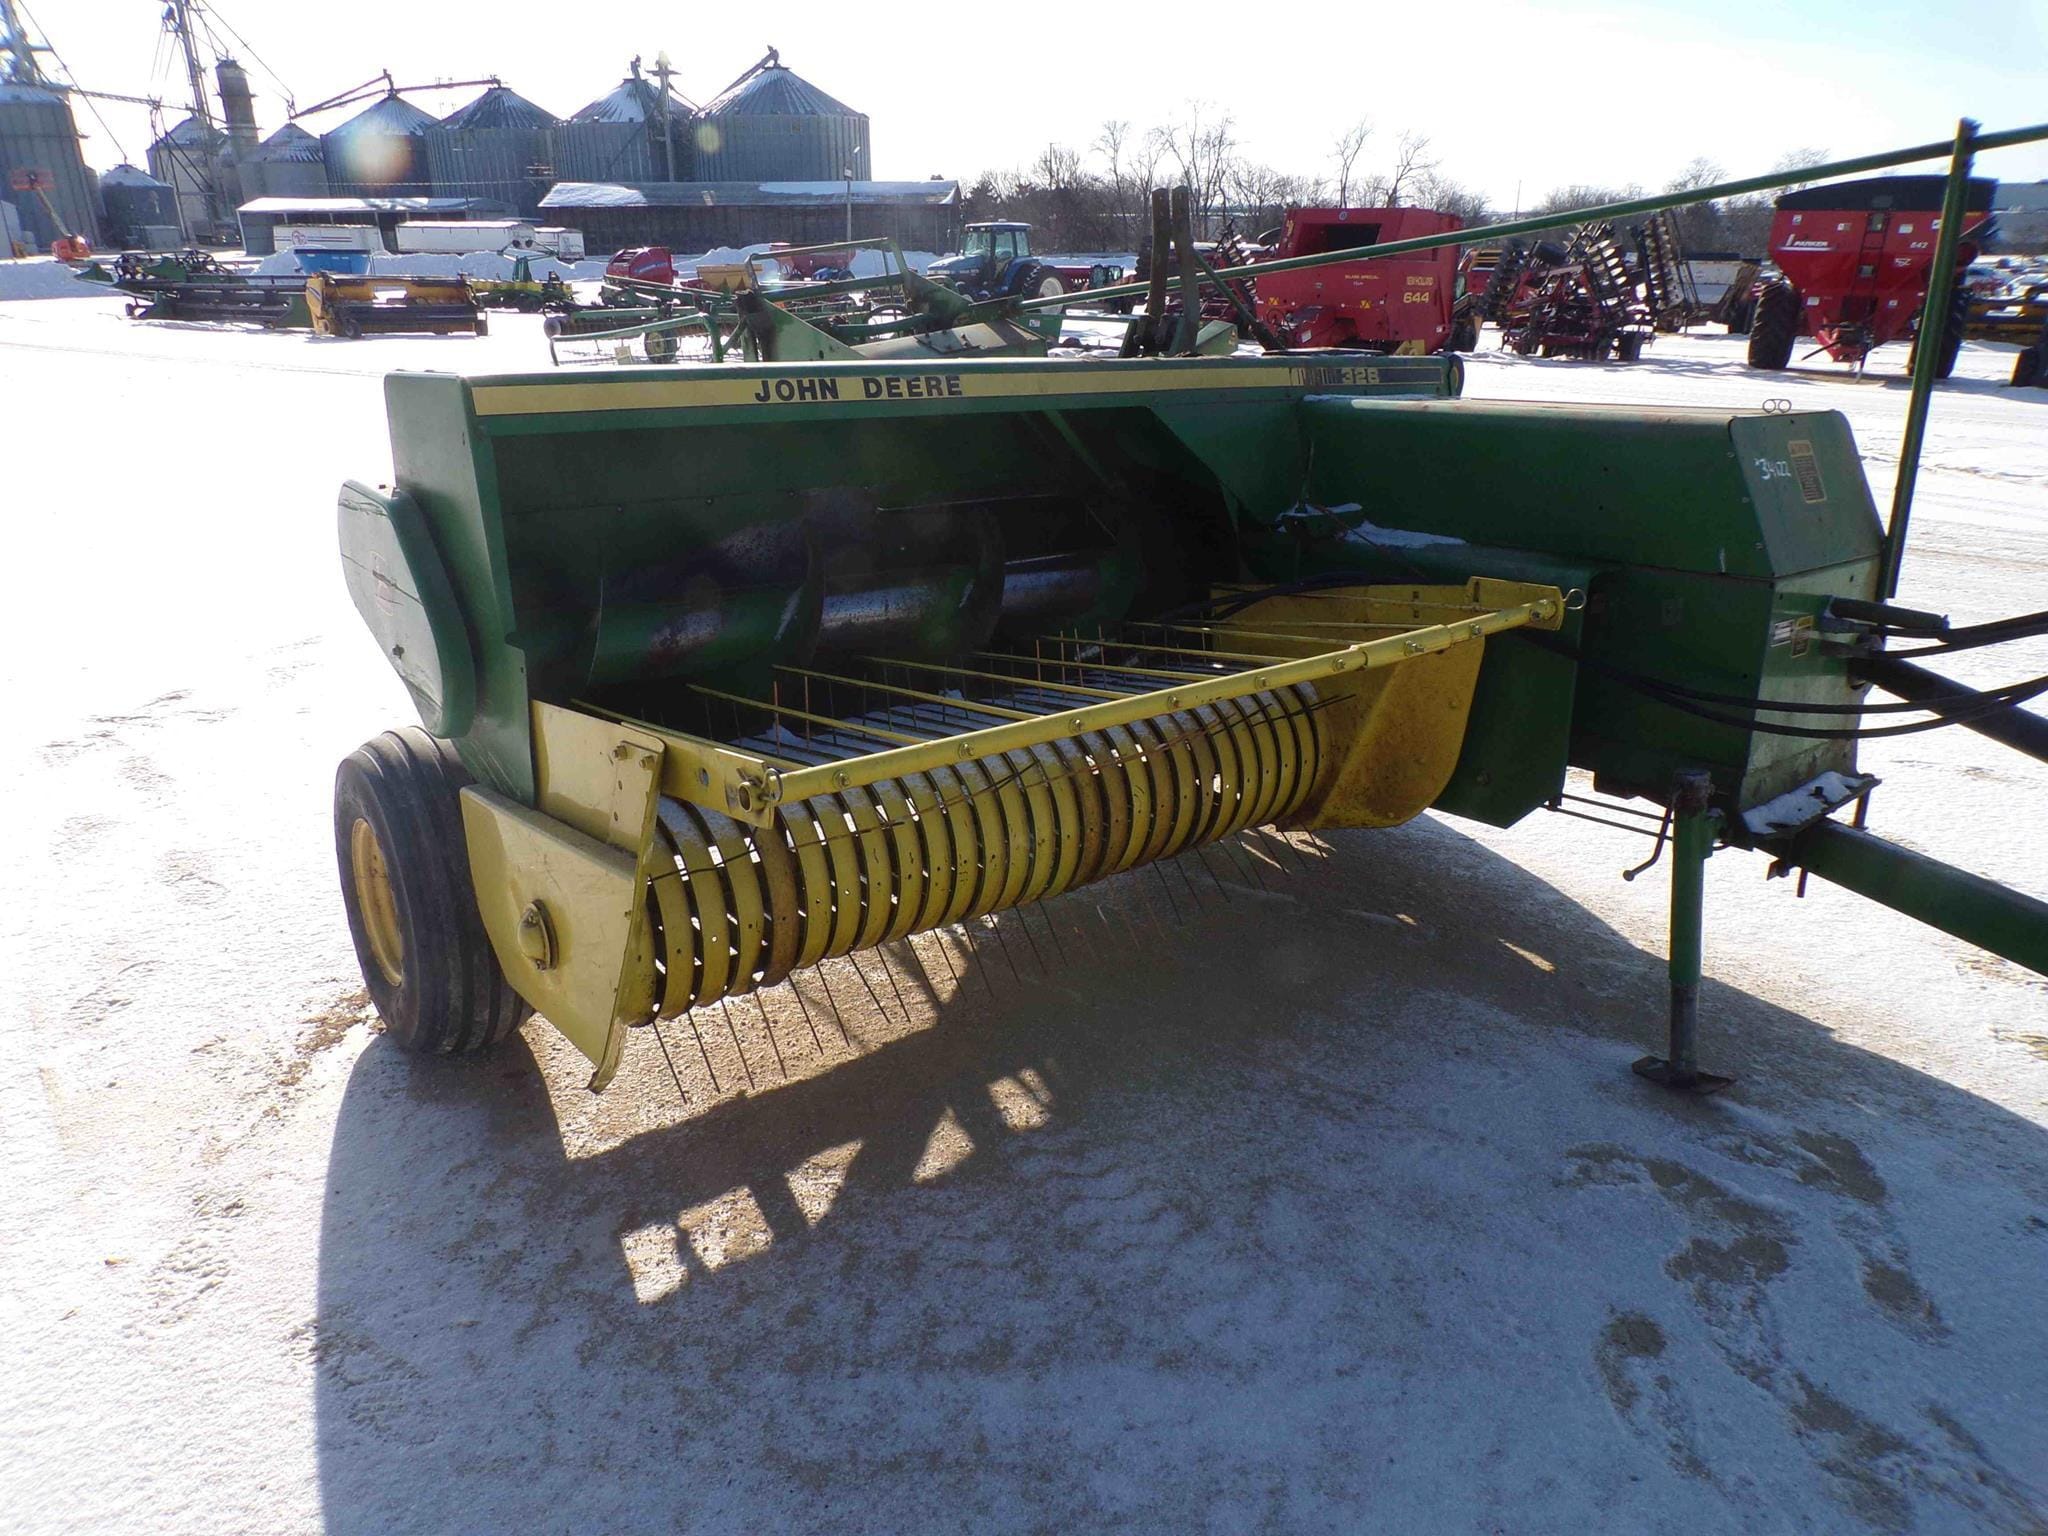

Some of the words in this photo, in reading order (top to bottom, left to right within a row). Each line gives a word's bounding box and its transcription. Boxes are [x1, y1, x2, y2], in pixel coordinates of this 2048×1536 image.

[1403, 292, 1430, 304] 644
[754, 377, 840, 402] JOHN
[862, 375, 963, 399] DEERE
